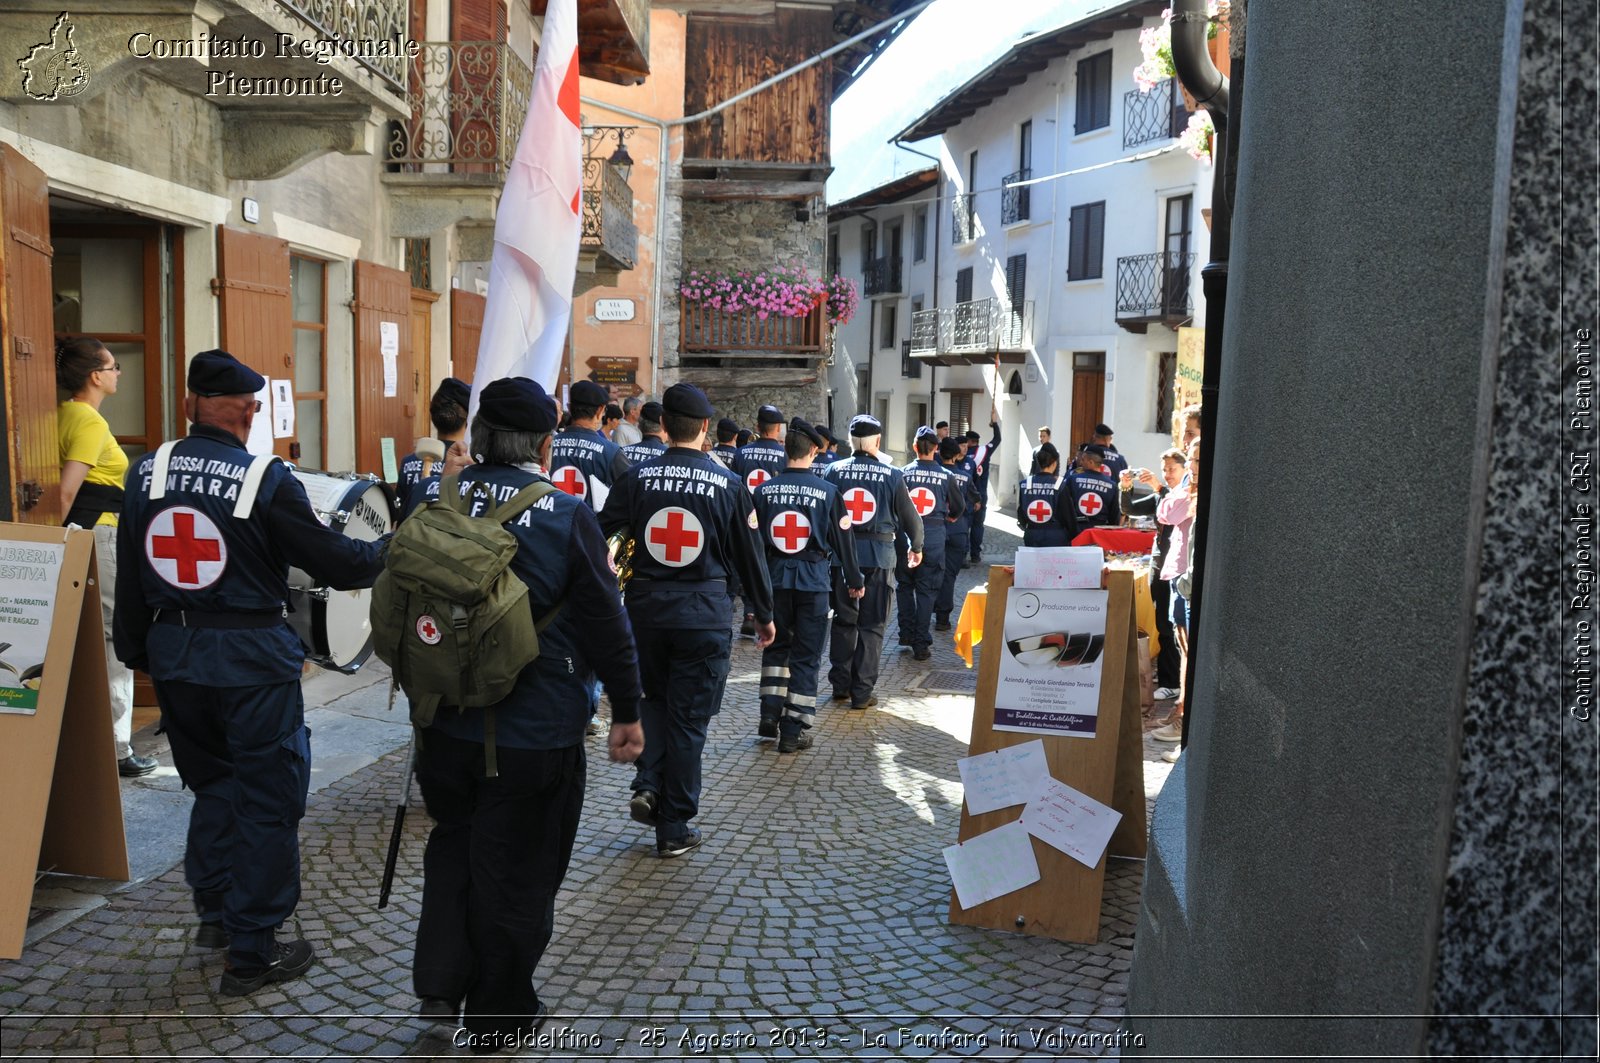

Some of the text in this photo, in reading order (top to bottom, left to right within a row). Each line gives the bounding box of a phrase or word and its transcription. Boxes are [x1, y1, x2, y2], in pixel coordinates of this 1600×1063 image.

[1186, 389, 1198, 398] del
[578, 439, 604, 454] ITALIANA
[552, 447, 593, 461] ANFARA
[743, 454, 778, 463] FANFARA
[168, 456, 205, 473] ROSSA
[204, 459, 247, 483] ITALIA
[851, 463, 868, 472] ROSSA
[868, 464, 892, 476] ITALIANA
[638, 465, 728, 490] CROCE ROSSA ITALIANA
[838, 471, 885, 482] FANFARA
[906, 475, 942, 486] FANFARA
[141, 474, 238, 501] FNFARA
[644, 478, 715, 499] FANFARA
[761, 484, 827, 501] CROCE ROSSA ITALIANA
[767, 494, 817, 508] FANFARA
[362, 502, 386, 537] YAMAHA
[13, 597, 49, 607] NARRATIVA
[1041, 603, 1100, 612] Produzione viticola
[13, 616, 40, 626] RAGAZZI
[1004, 676, 1095, 689] Azienda Agricola Giordanino Teresio
[1049, 715, 1083, 725] Casteldelfino
